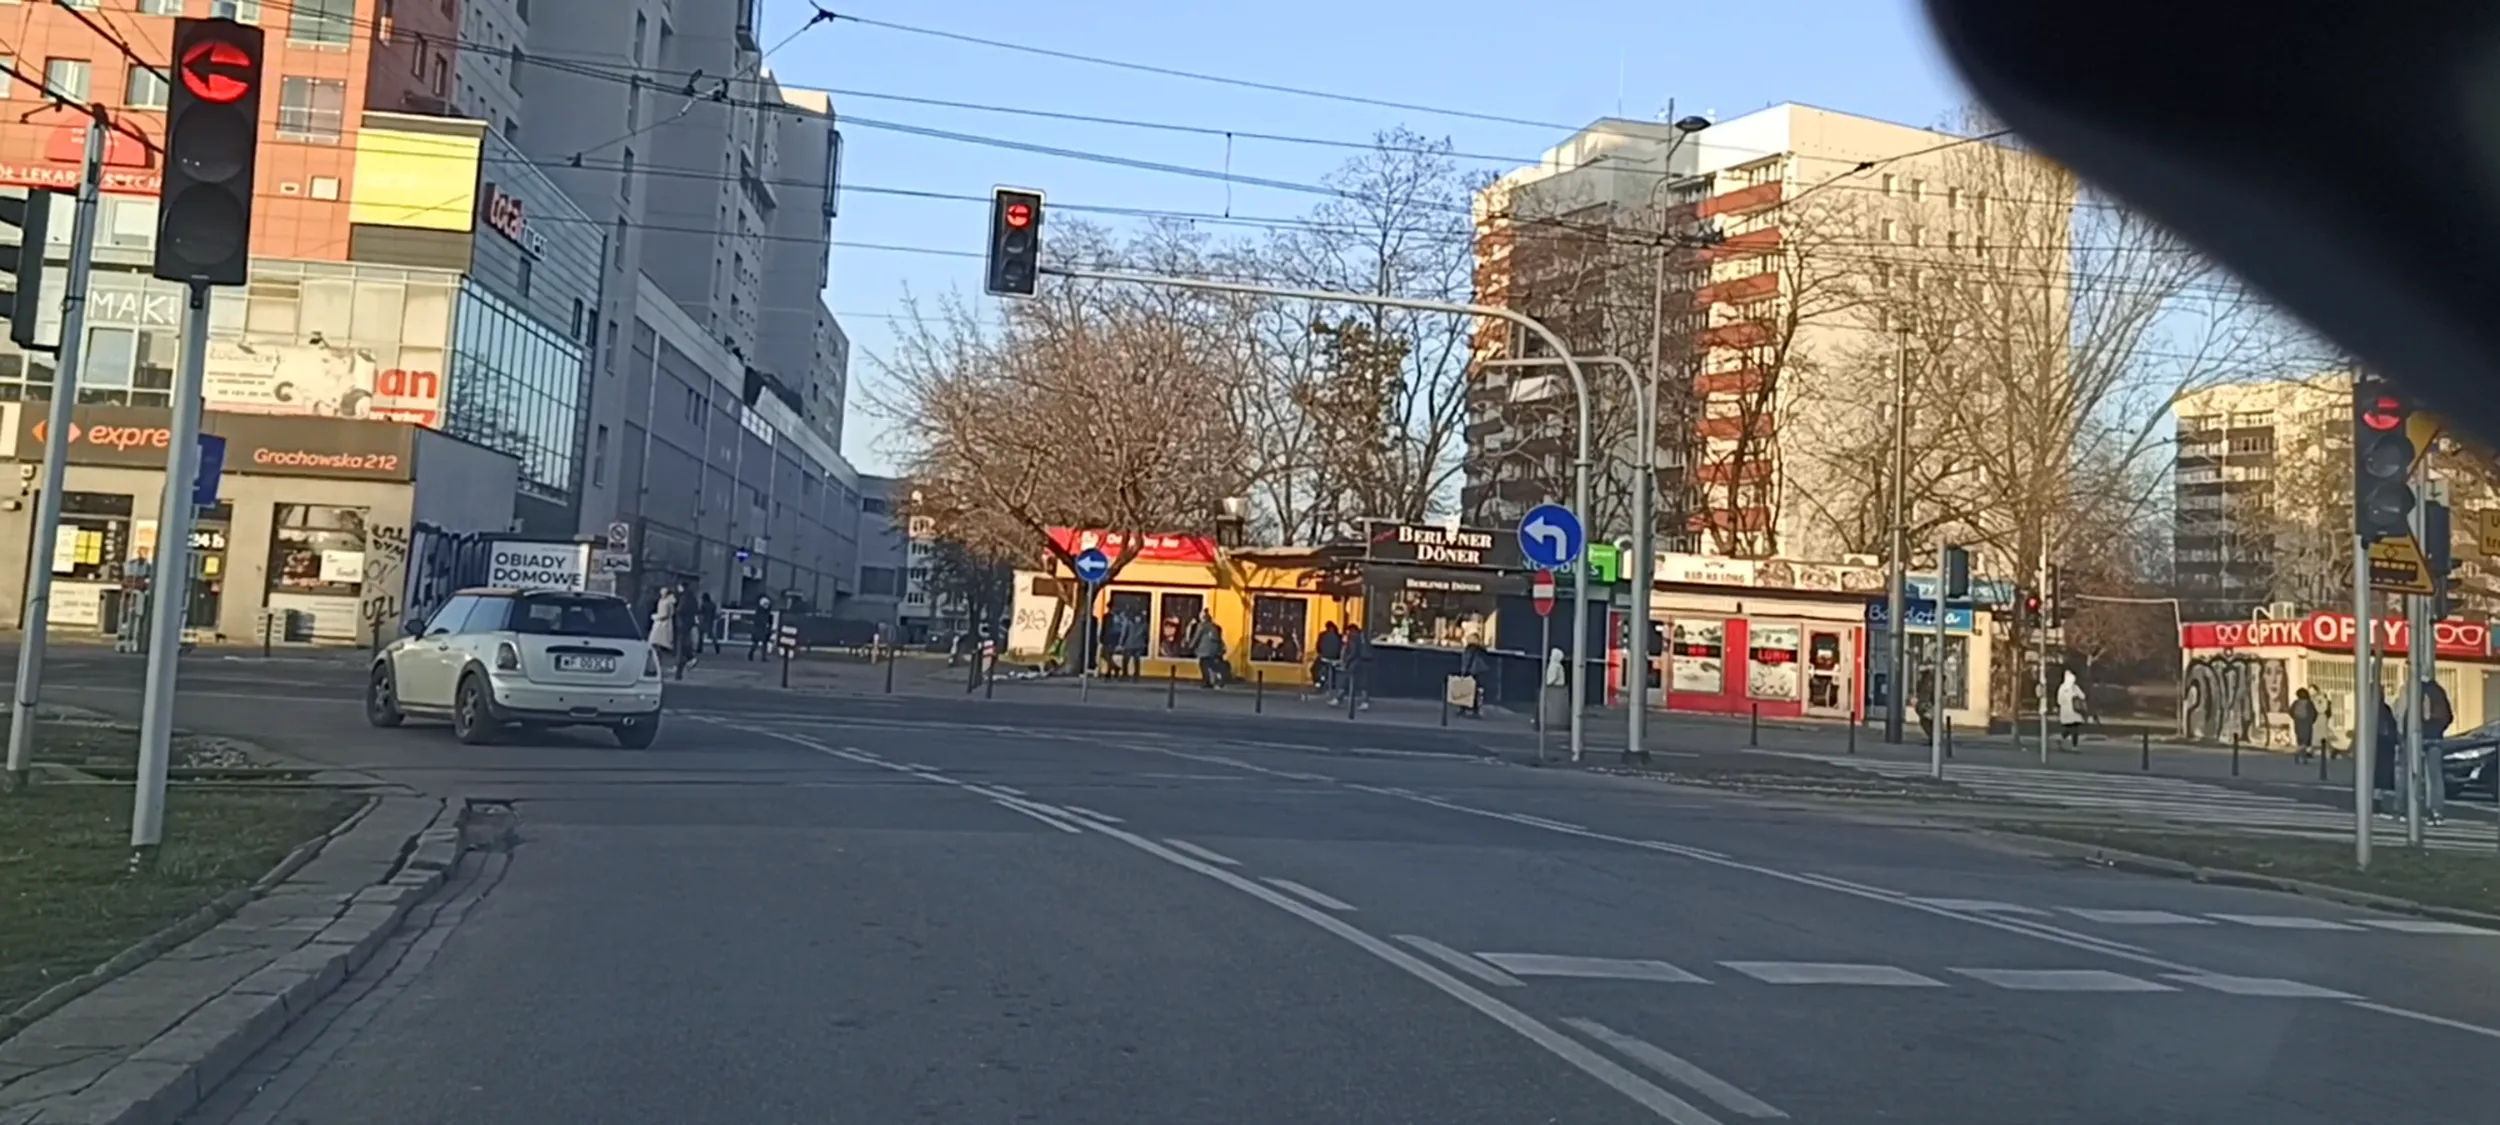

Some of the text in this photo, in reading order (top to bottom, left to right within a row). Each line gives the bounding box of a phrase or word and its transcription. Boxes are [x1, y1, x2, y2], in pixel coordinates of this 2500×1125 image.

[21, 166, 77, 185] LEKAR
[88, 424, 171, 452] expre
[253, 447, 398, 471] Grochowska 212
[495, 551, 566, 569] OBIADY
[1416, 543, 1481, 565] DÖNER
[493, 567, 582, 587] DOMOWE
[2247, 621, 2304, 645] OPTYK
[2313, 614, 2410, 647] OPTY
